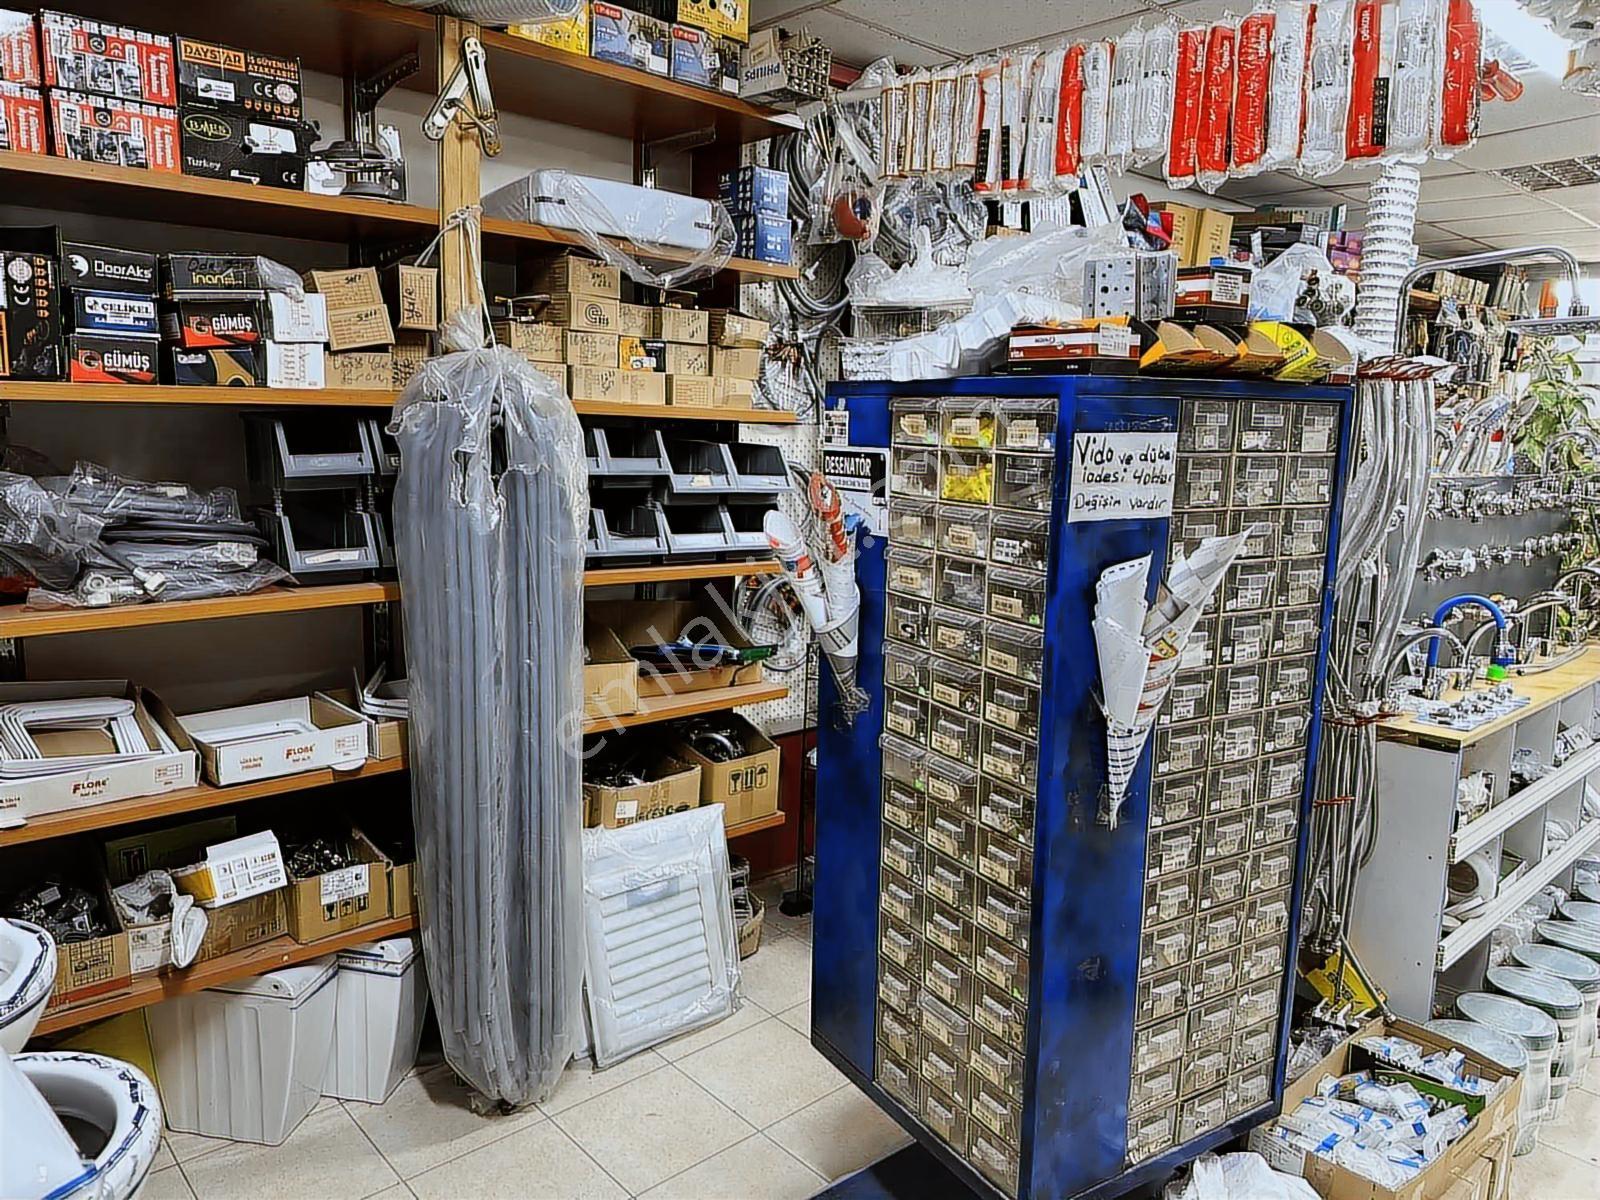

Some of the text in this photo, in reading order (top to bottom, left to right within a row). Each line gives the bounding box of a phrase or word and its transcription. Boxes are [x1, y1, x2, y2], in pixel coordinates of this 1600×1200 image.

[744, 62, 781, 82] PHILIPS
[185, 156, 221, 171] Turkey
[94, 259, 152, 279] DoorAks
[211, 313, 253, 332] GÜMÜŞ
[103, 350, 151, 371] GÜMÜŞ
[1119, 452, 1134, 465] ve
